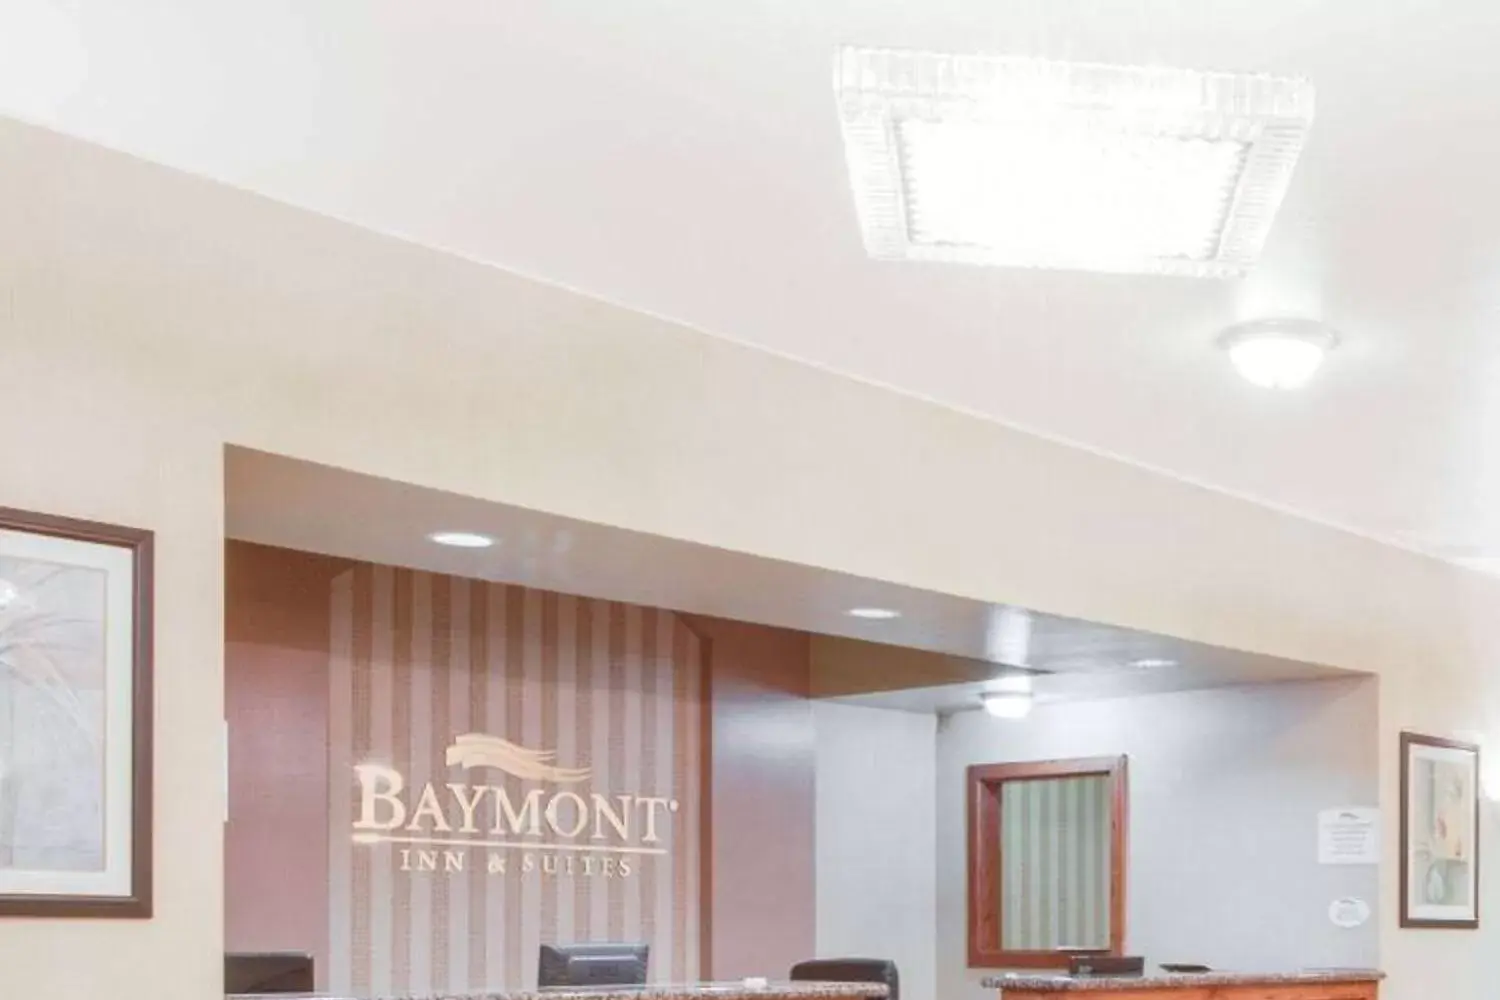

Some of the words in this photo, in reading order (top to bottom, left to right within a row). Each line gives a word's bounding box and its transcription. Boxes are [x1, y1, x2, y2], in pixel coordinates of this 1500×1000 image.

[353, 763, 667, 841] BAYMONT
[401, 849, 466, 872] INN
[487, 853, 506, 874] &
[522, 853, 632, 878] SUITES
